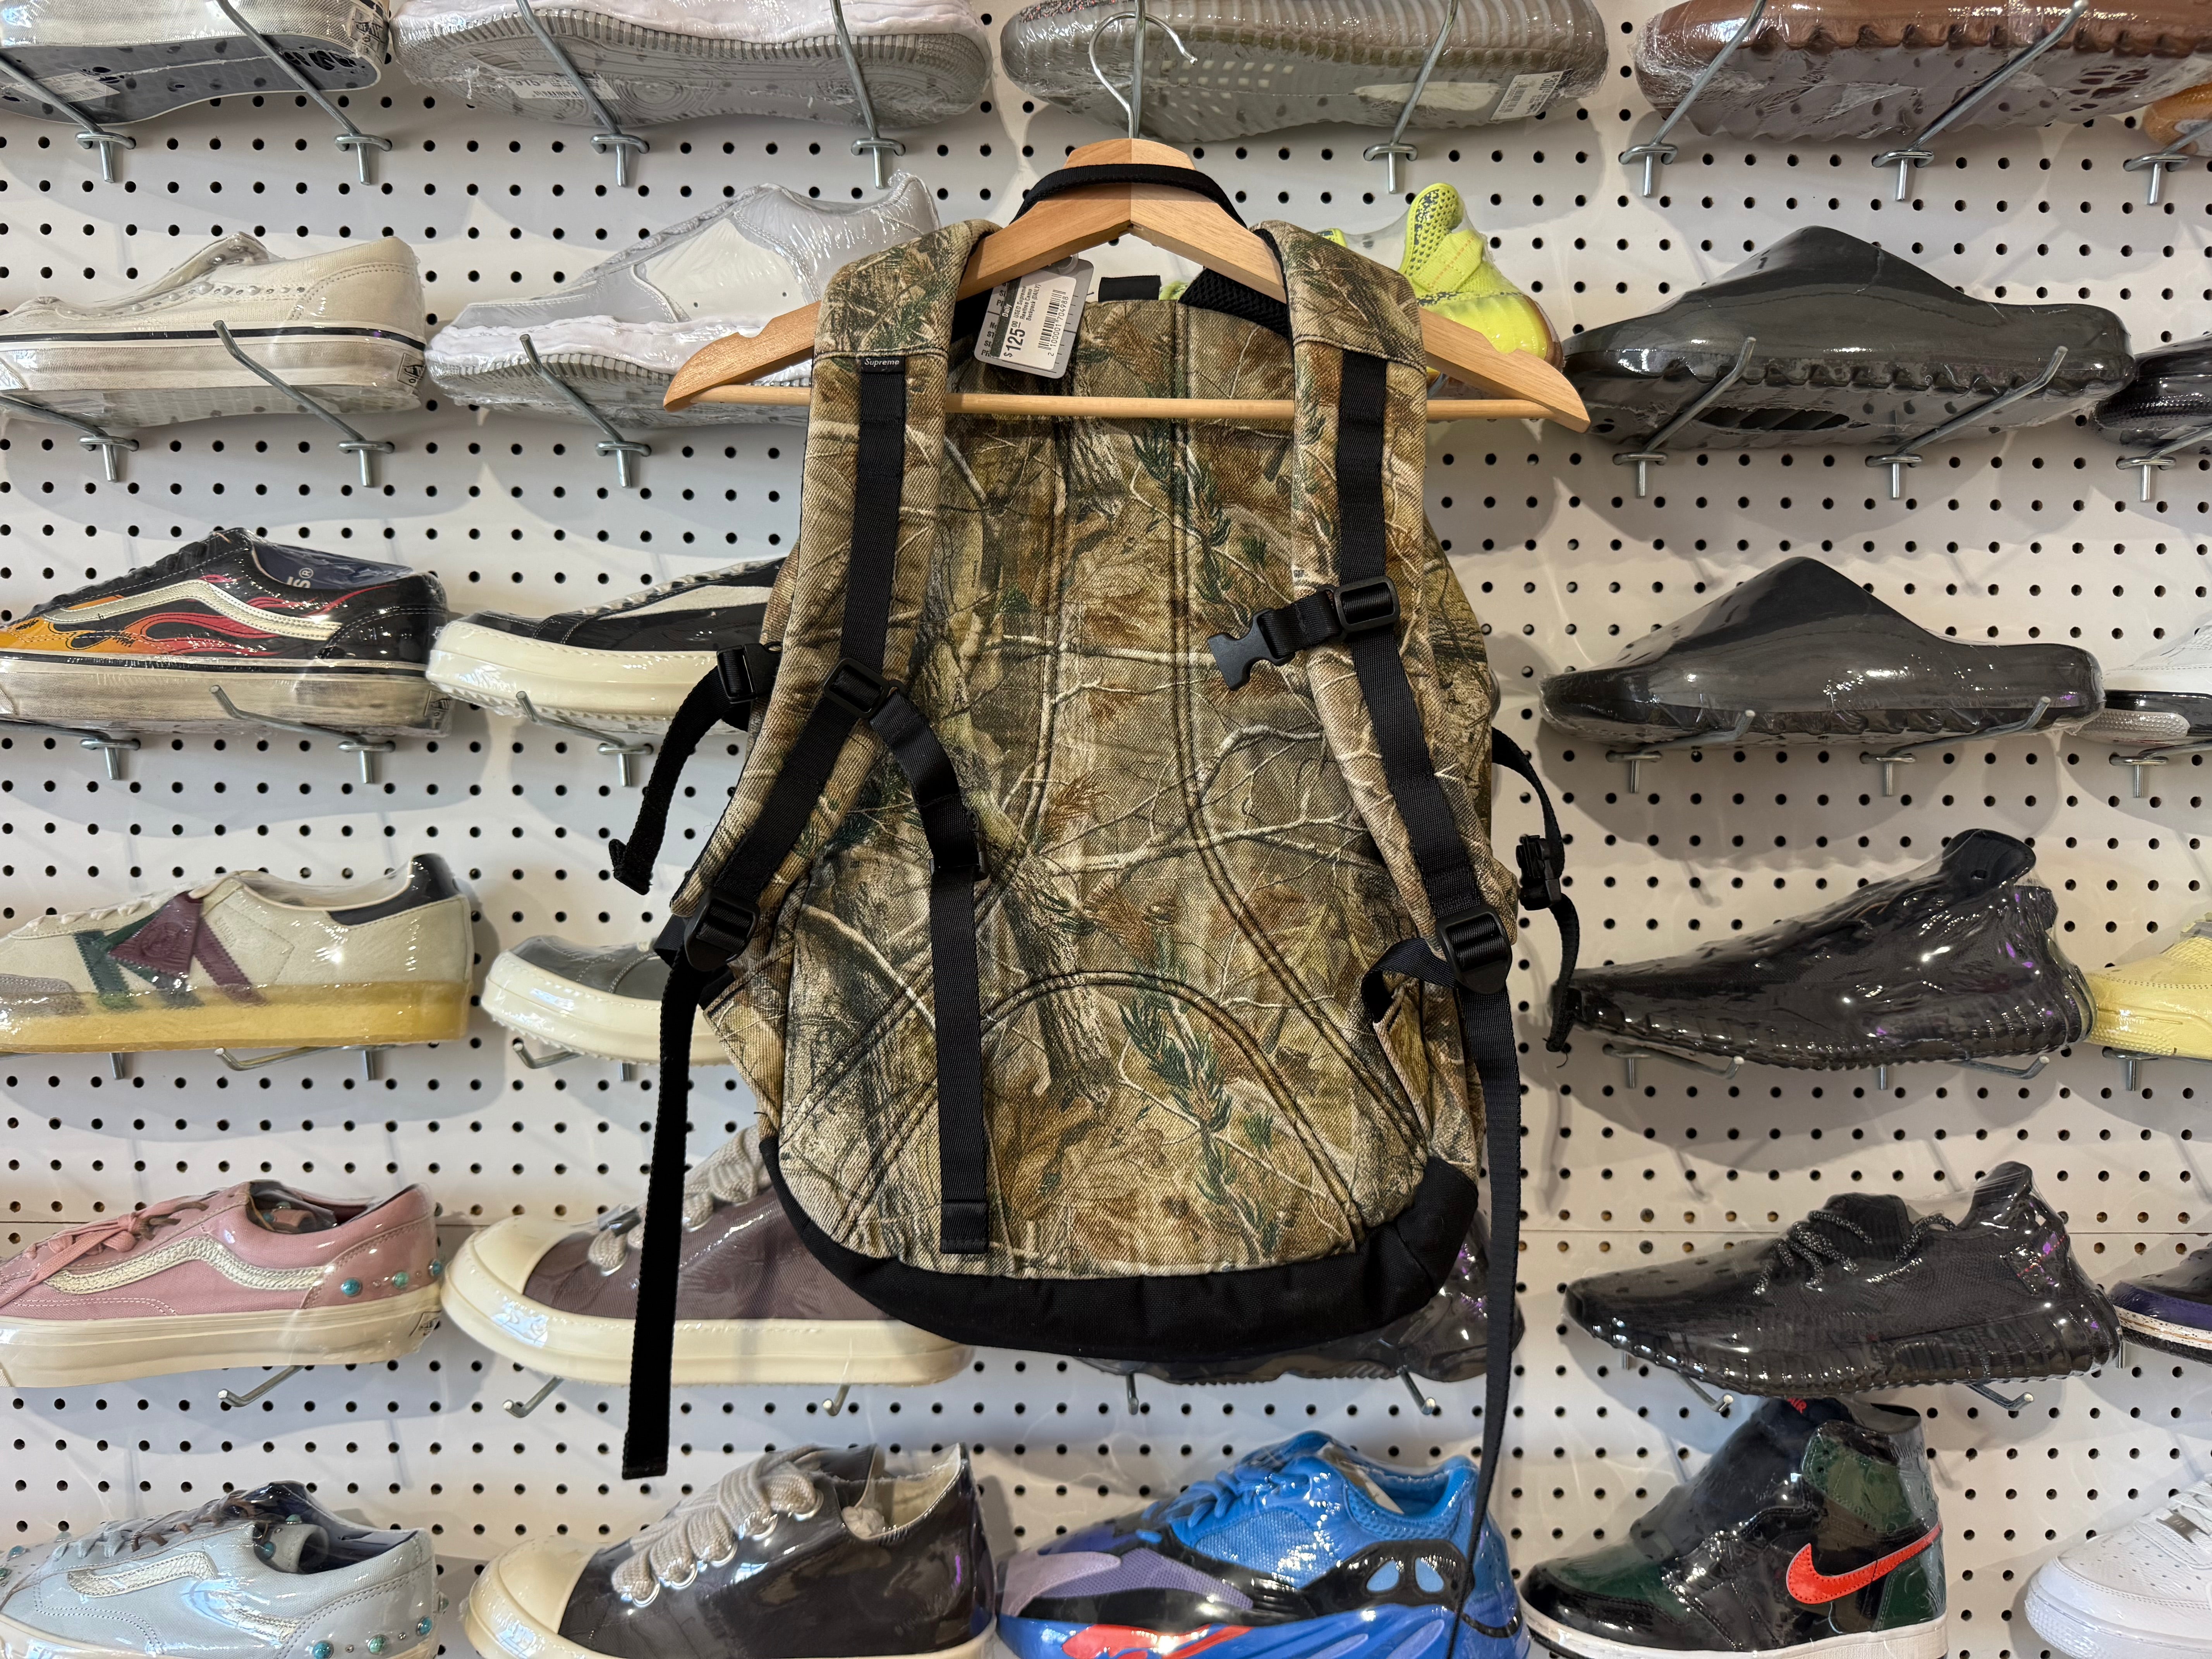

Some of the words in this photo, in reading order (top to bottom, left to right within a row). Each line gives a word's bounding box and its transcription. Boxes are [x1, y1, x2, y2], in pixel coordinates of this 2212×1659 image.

[1017, 286, 1026, 305] Supreme
[1026, 301, 1036, 321] Backpack
[1032, 284, 1041, 300] (DAILY)
[1002, 304, 1012, 318] Daily
[1020, 301, 1029, 319] Realtree
[1050, 324, 1061, 347] 100001
[1057, 296, 1069, 320] 704988
[865, 358, 900, 368] Supreme
